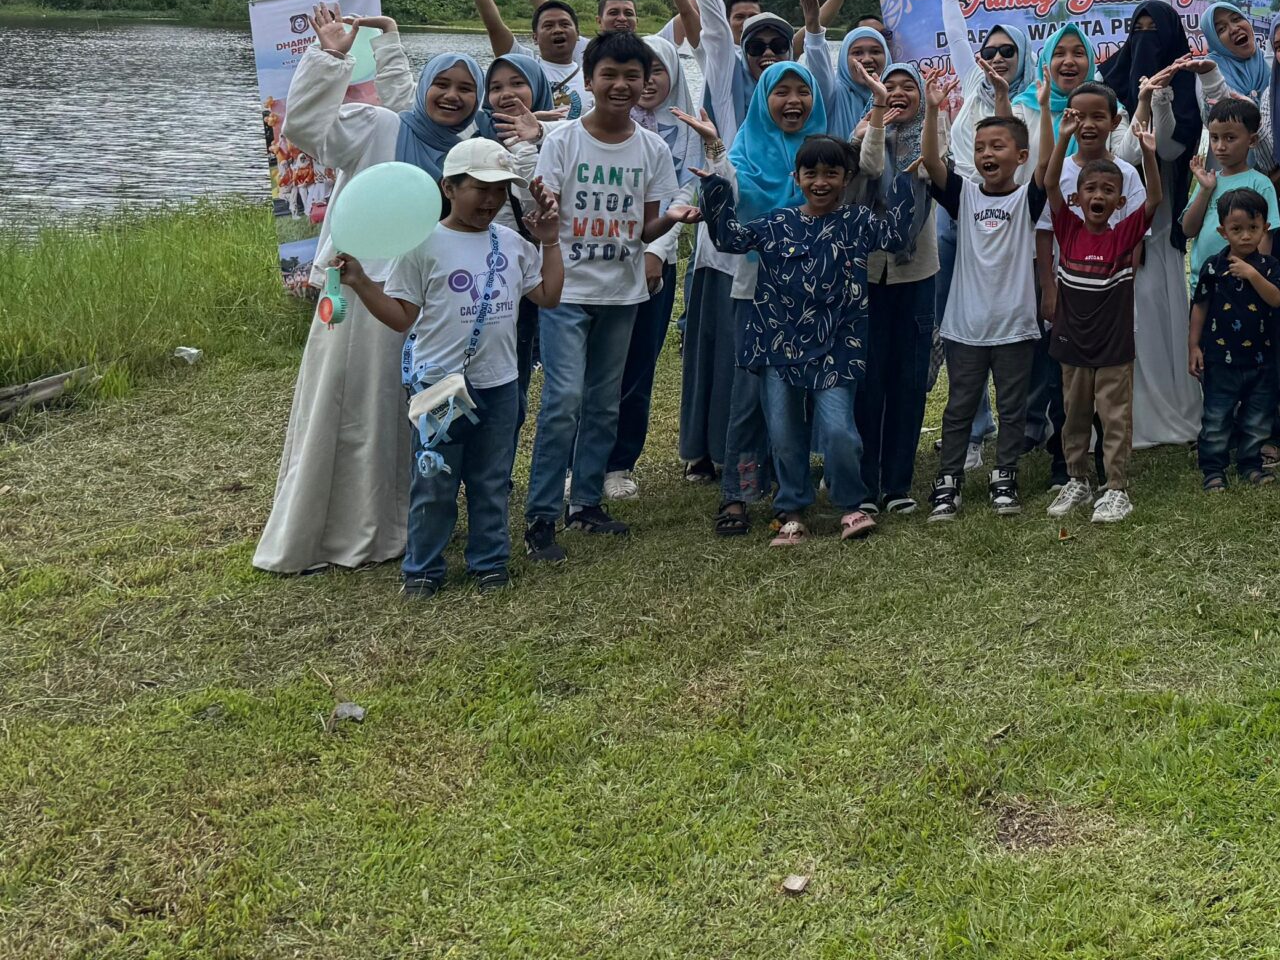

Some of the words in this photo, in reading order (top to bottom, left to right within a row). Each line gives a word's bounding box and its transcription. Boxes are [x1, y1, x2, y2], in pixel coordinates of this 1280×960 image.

[577, 163, 643, 187] CAN'T
[575, 190, 634, 213] STOP
[573, 217, 638, 239] WON'T
[569, 242, 631, 262] STOP
